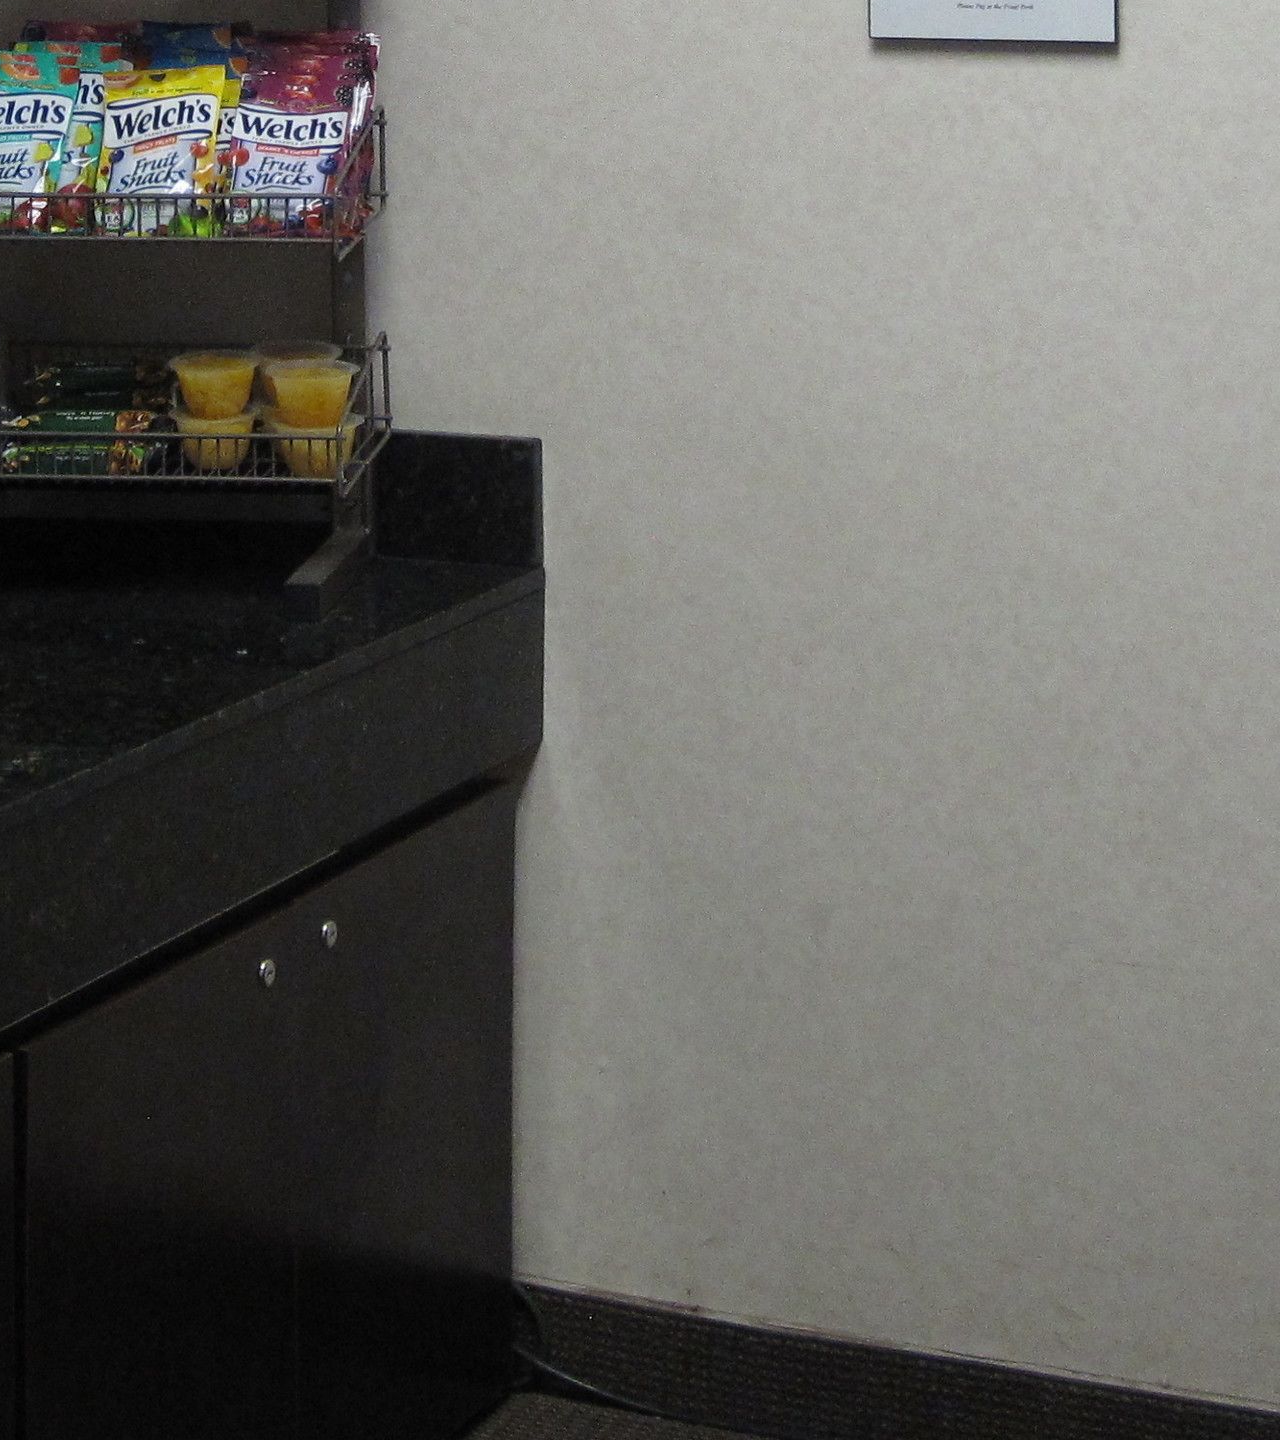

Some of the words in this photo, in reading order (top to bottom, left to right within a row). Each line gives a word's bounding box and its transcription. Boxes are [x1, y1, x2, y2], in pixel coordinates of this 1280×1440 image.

[110, 98, 213, 141] Welch's
[238, 112, 344, 141] Welch's
[132, 151, 179, 177] Fruit
[259, 156, 308, 172] Fruit
[115, 167, 186, 192] Snacks
[241, 167, 315, 188] Snacks
